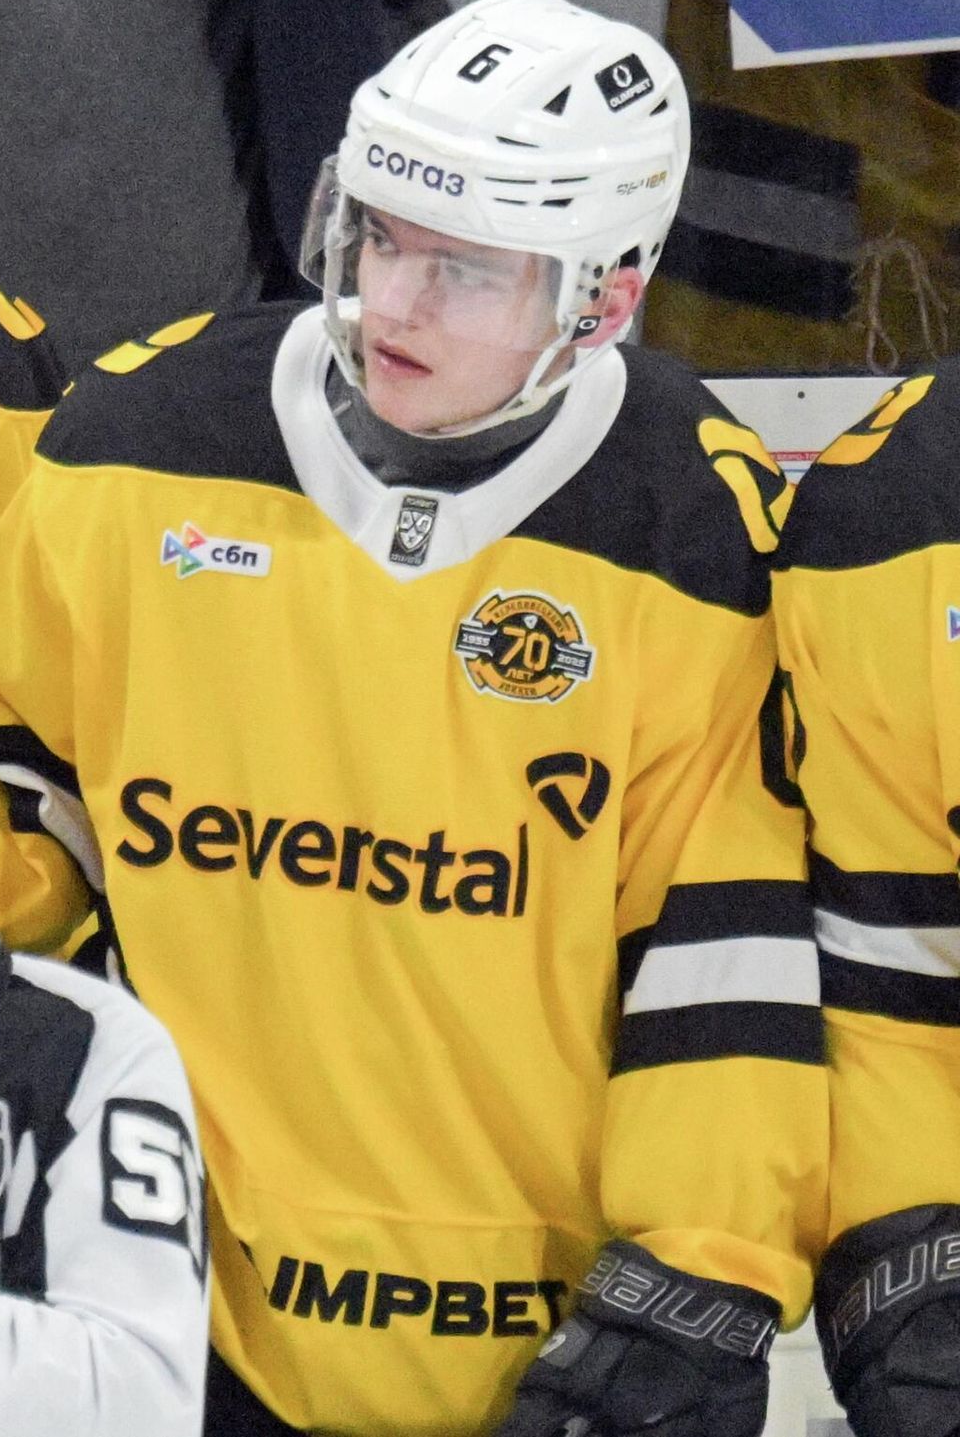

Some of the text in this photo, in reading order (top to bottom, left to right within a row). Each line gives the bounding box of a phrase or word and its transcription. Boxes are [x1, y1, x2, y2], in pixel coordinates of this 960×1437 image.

[457, 44, 514, 84] 6
[367, 144, 466, 198] согаз
[210, 545, 258, 567] сбп
[499, 626, 551, 672] 70
[116, 778, 530, 918] Severstal
[268, 1255, 569, 1338] IMPBET
